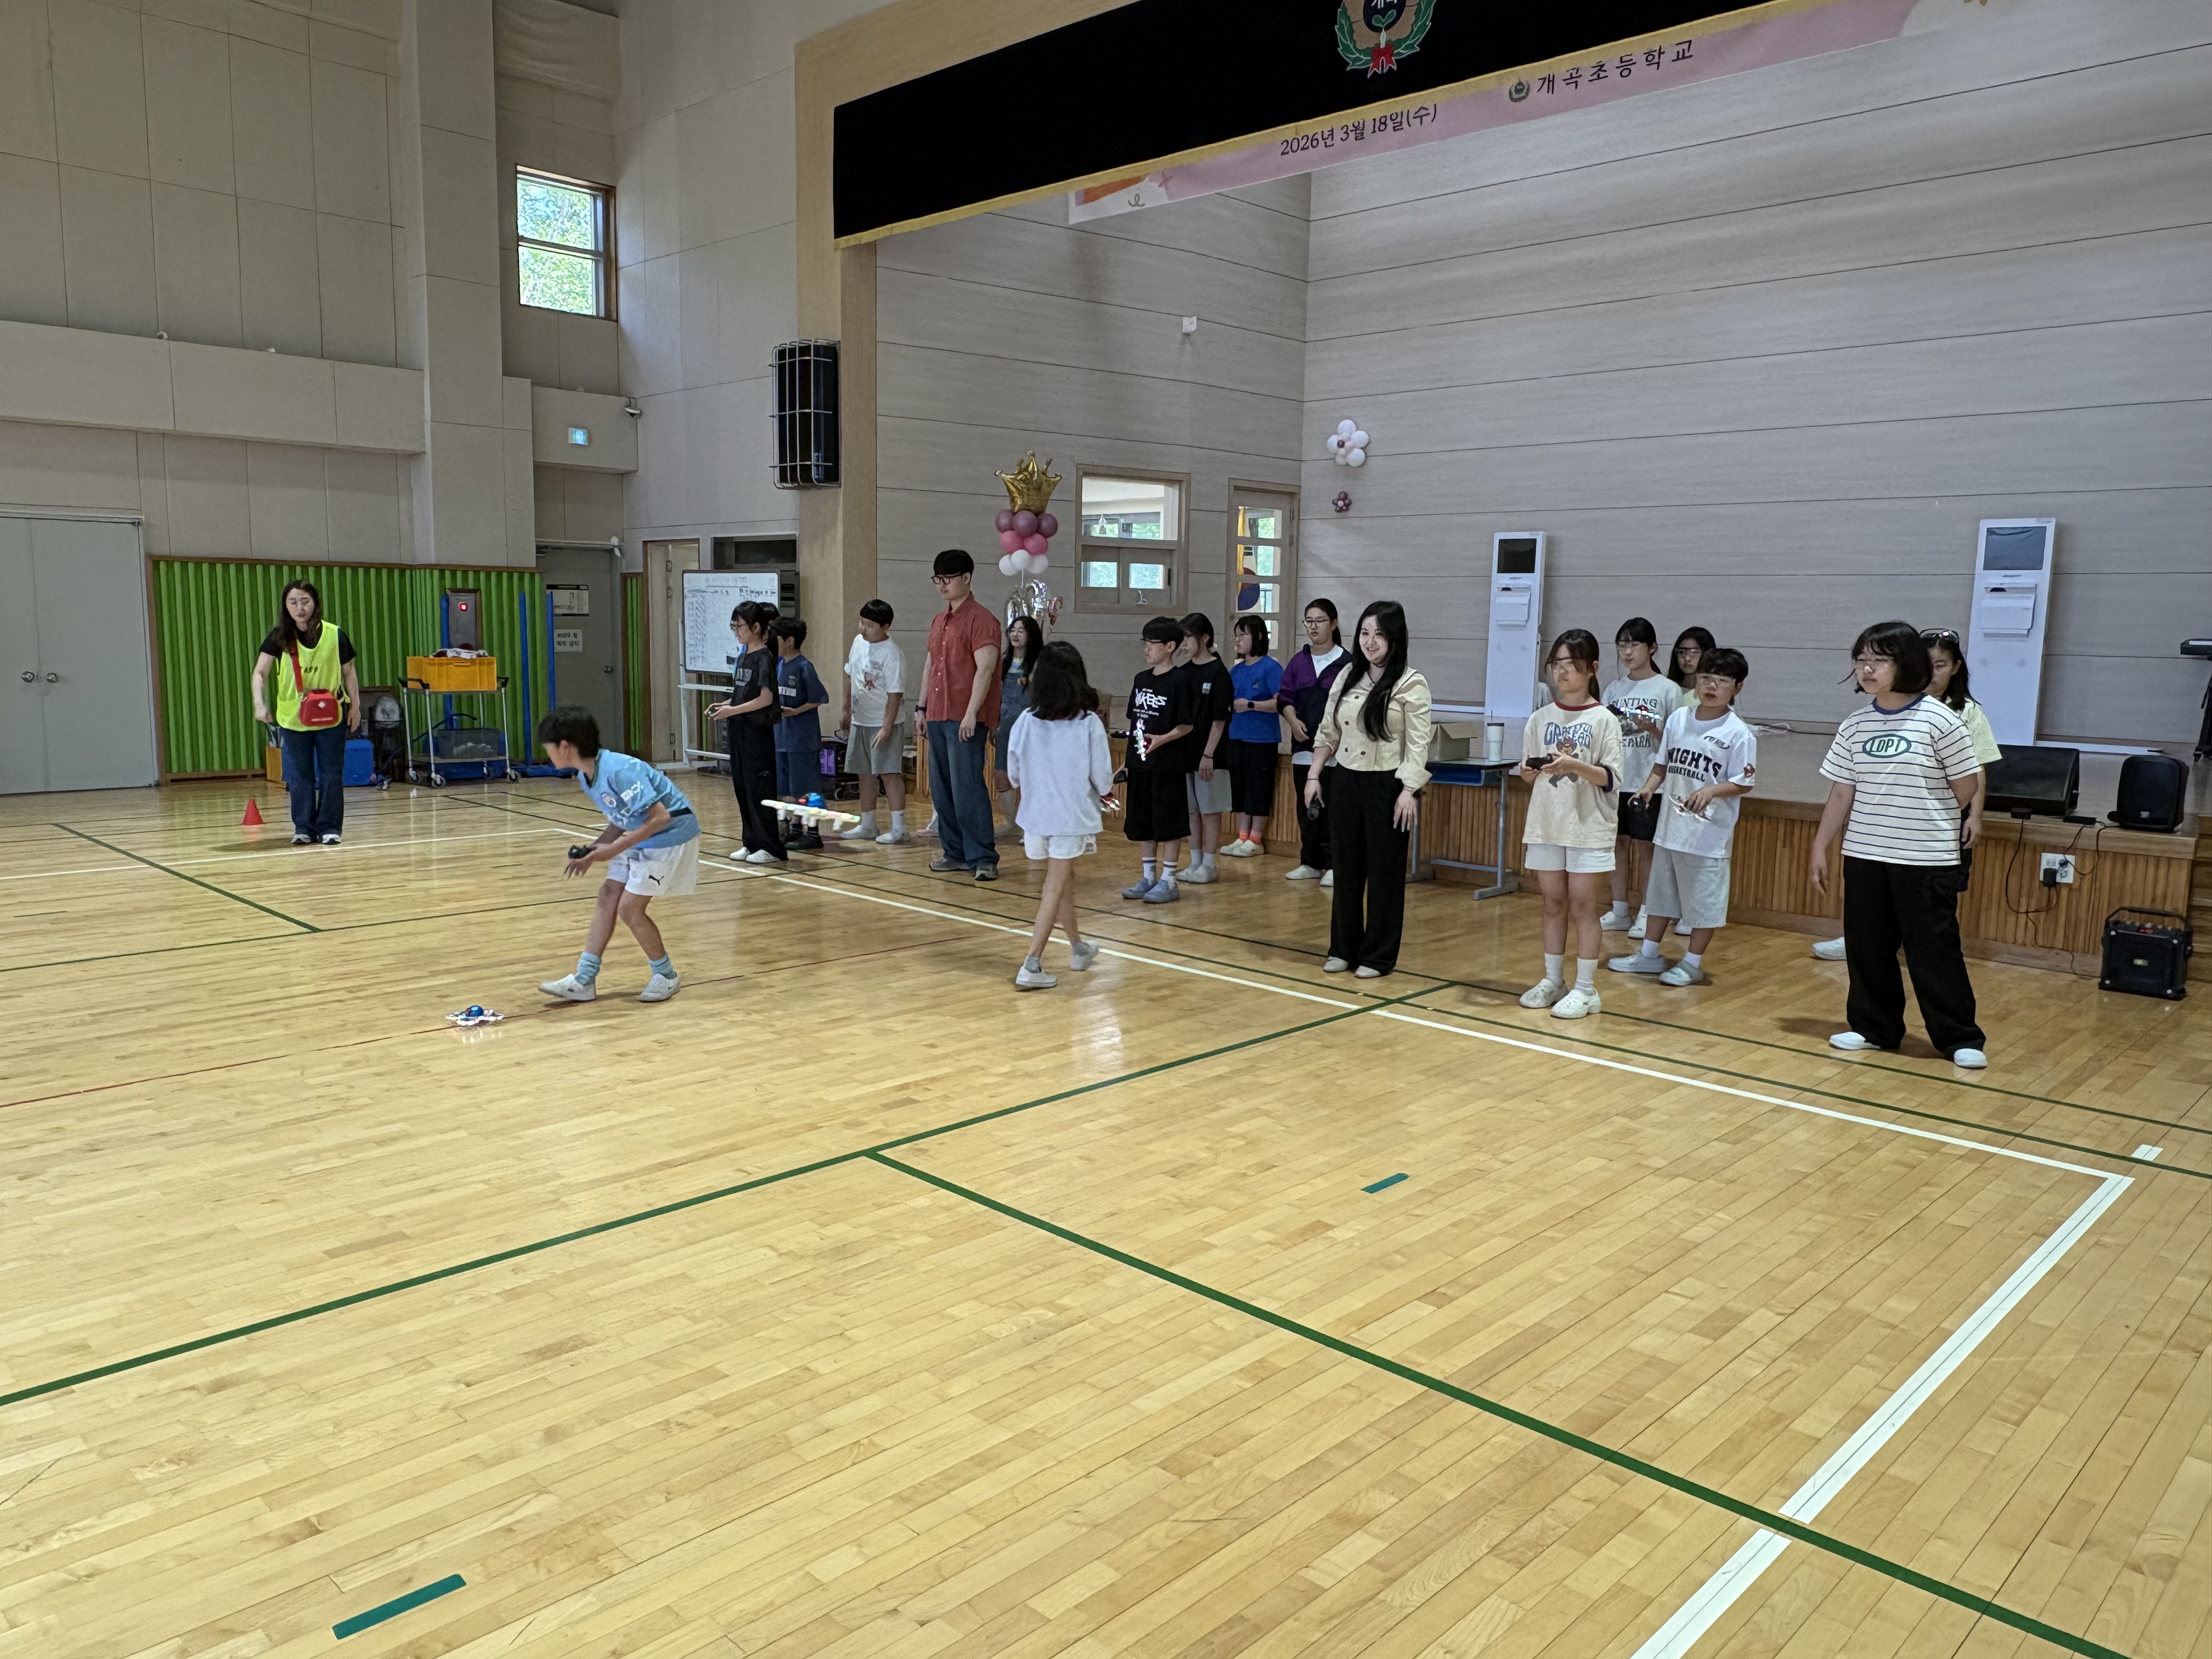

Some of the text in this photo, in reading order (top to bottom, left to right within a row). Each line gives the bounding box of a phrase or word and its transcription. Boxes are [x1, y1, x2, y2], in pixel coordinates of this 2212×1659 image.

[1537, 40, 1694, 94] 개곡초등학교
[1280, 104, 1437, 156] 2026년 3월 18일(수)
[1668, 747, 1722, 777] NIGHTS
